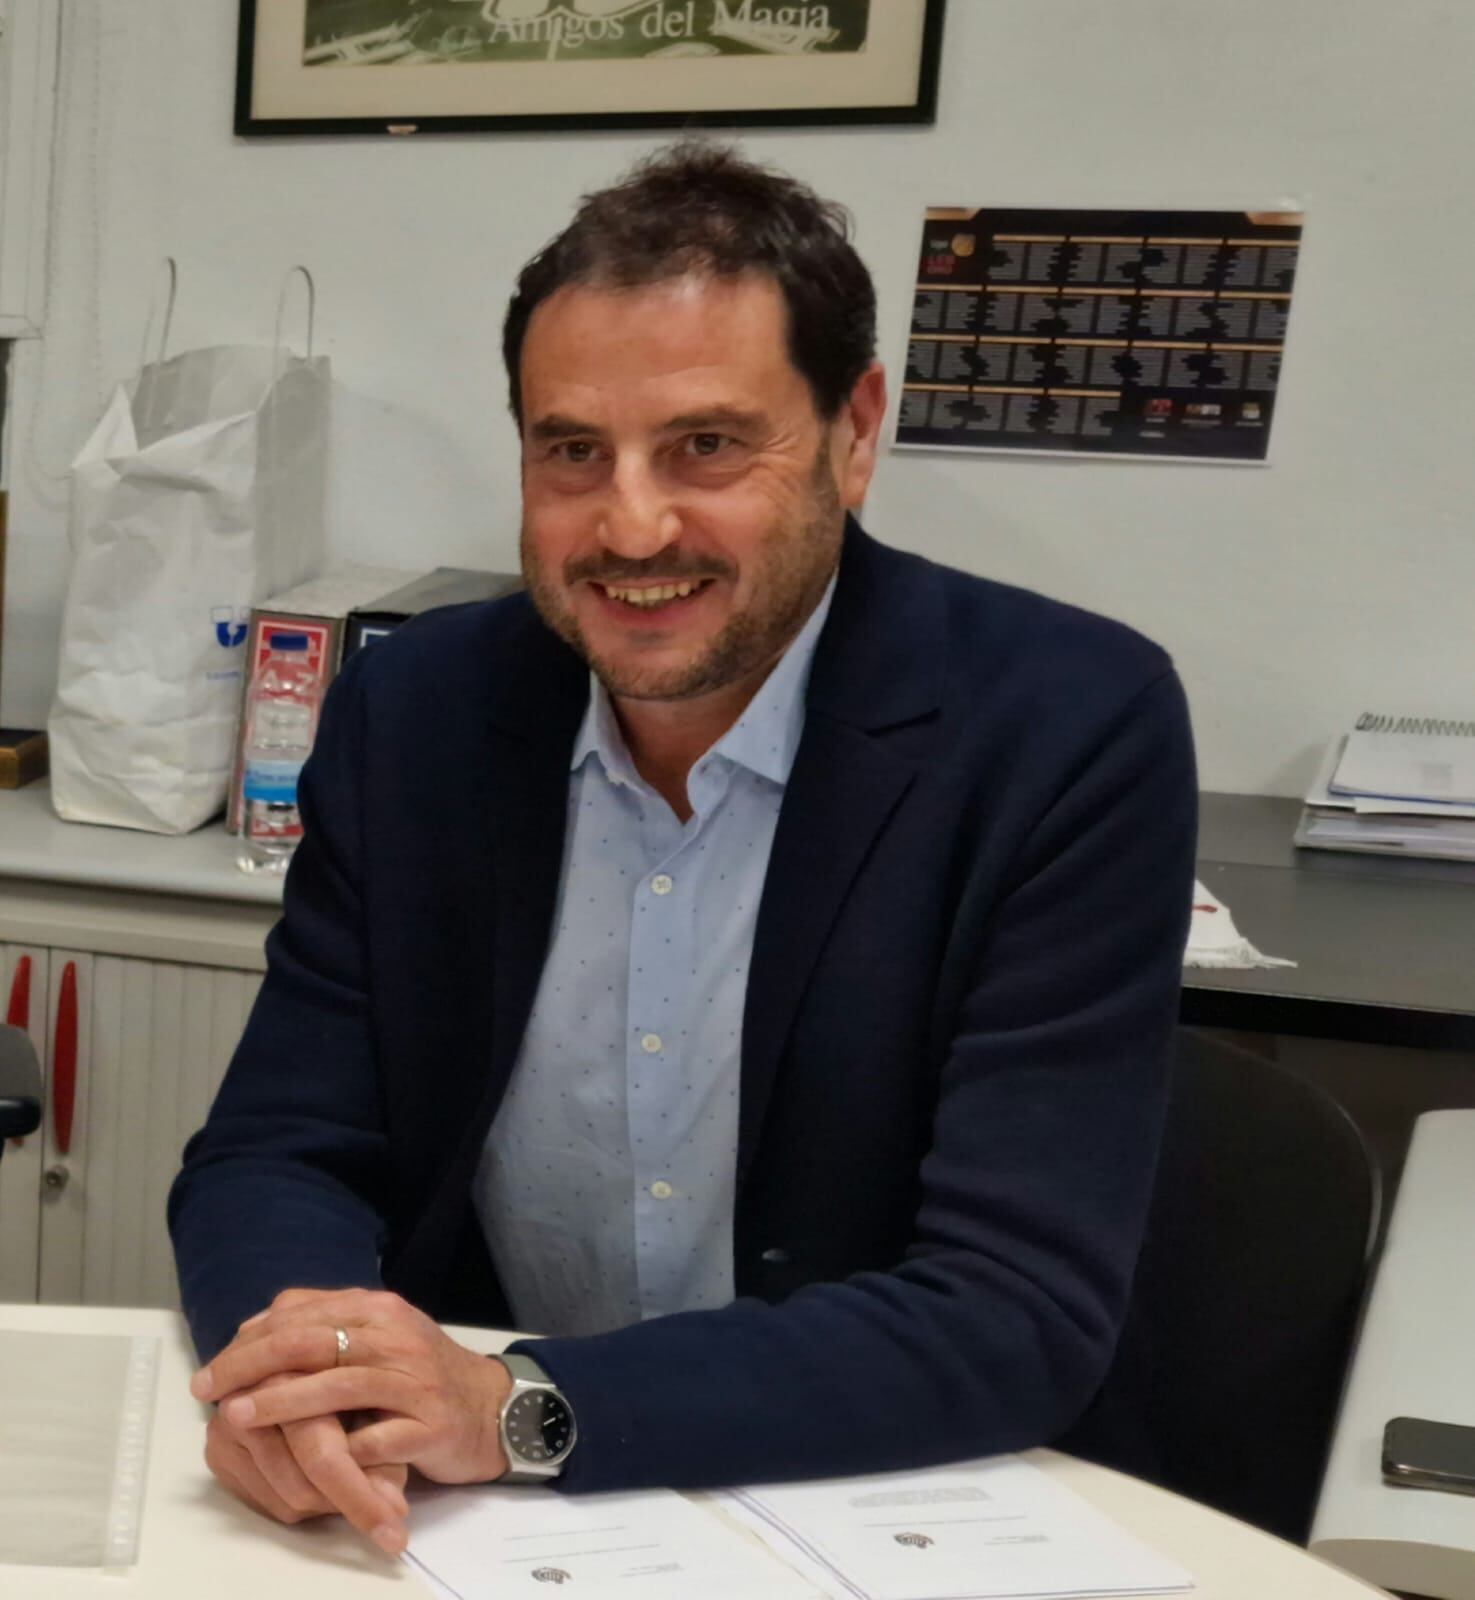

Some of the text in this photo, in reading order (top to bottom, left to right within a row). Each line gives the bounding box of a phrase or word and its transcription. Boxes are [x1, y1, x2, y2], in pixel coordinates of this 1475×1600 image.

[487, 0, 831, 48] Amigos del Magia
